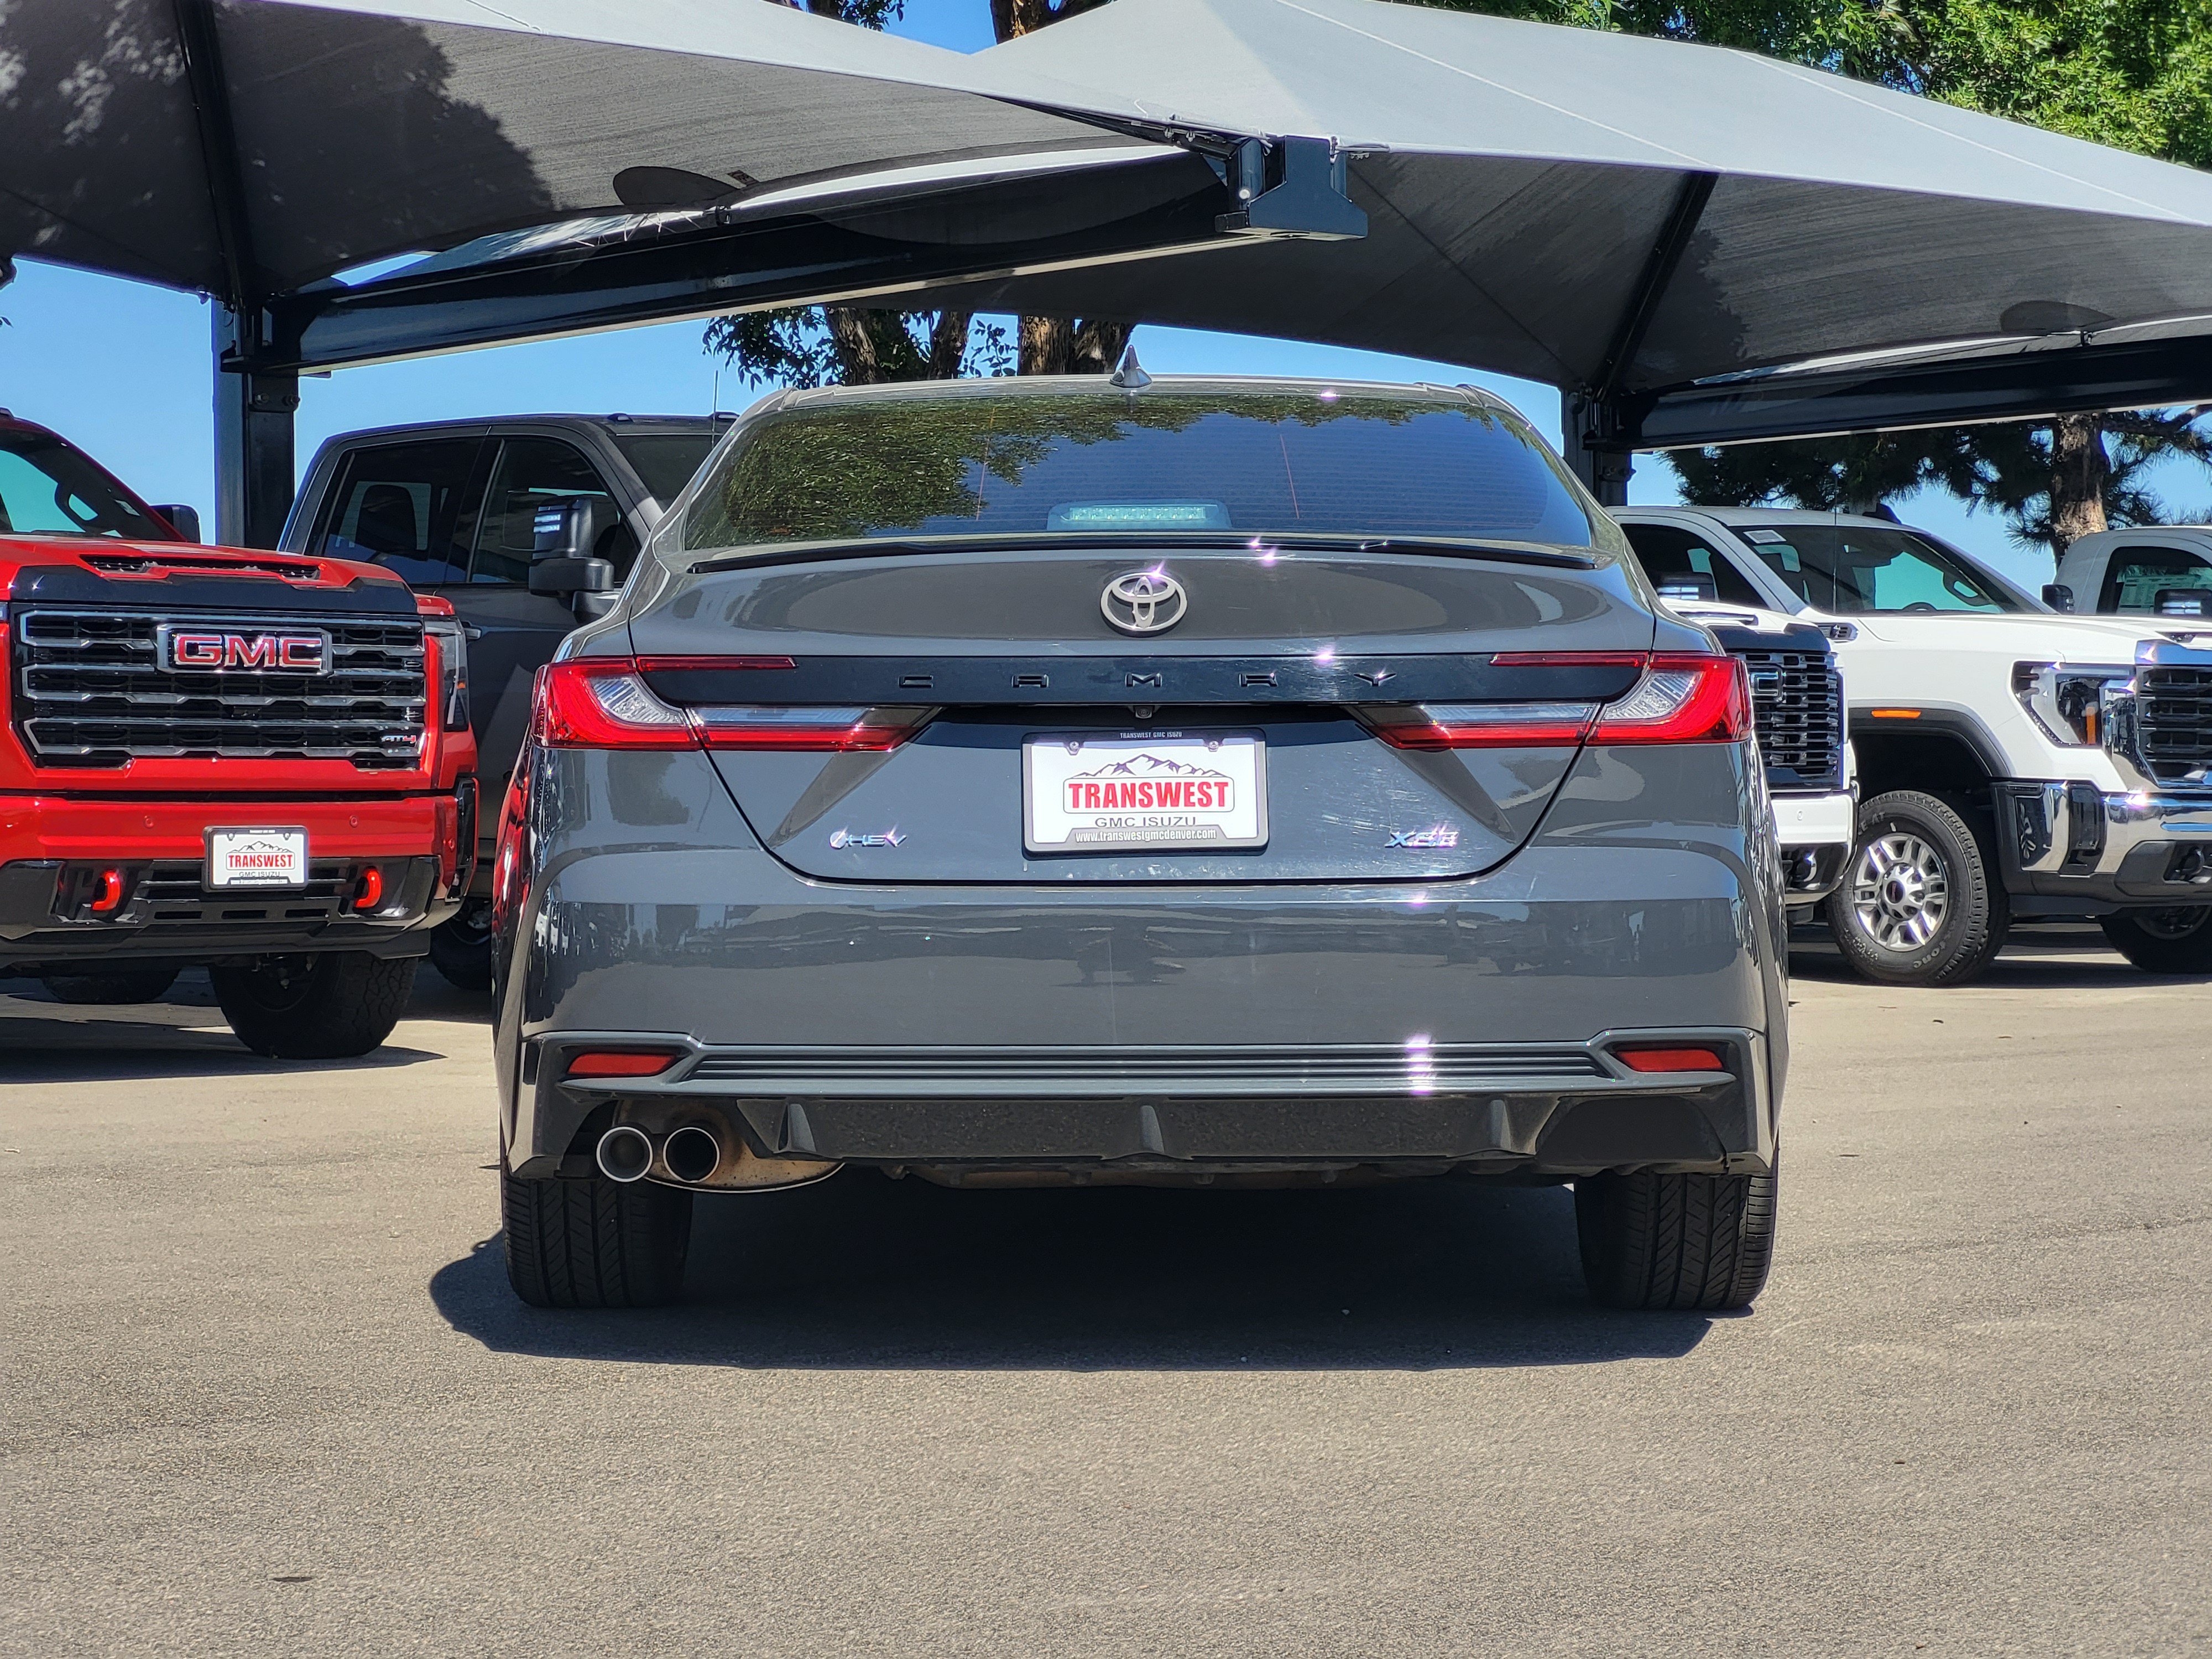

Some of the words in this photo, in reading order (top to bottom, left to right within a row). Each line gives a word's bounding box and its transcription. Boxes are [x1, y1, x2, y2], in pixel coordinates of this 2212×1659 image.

[174, 633, 323, 668] GMC
[898, 672, 1397, 689] CAMRY
[1069, 782, 1229, 808] TRANSWEST
[1095, 817, 1135, 827] GMC
[1143, 817, 1196, 826] ISUZU
[1075, 829, 1217, 842] www.transwestgmcdenver.com
[228, 854, 293, 867] TRANSWEST
